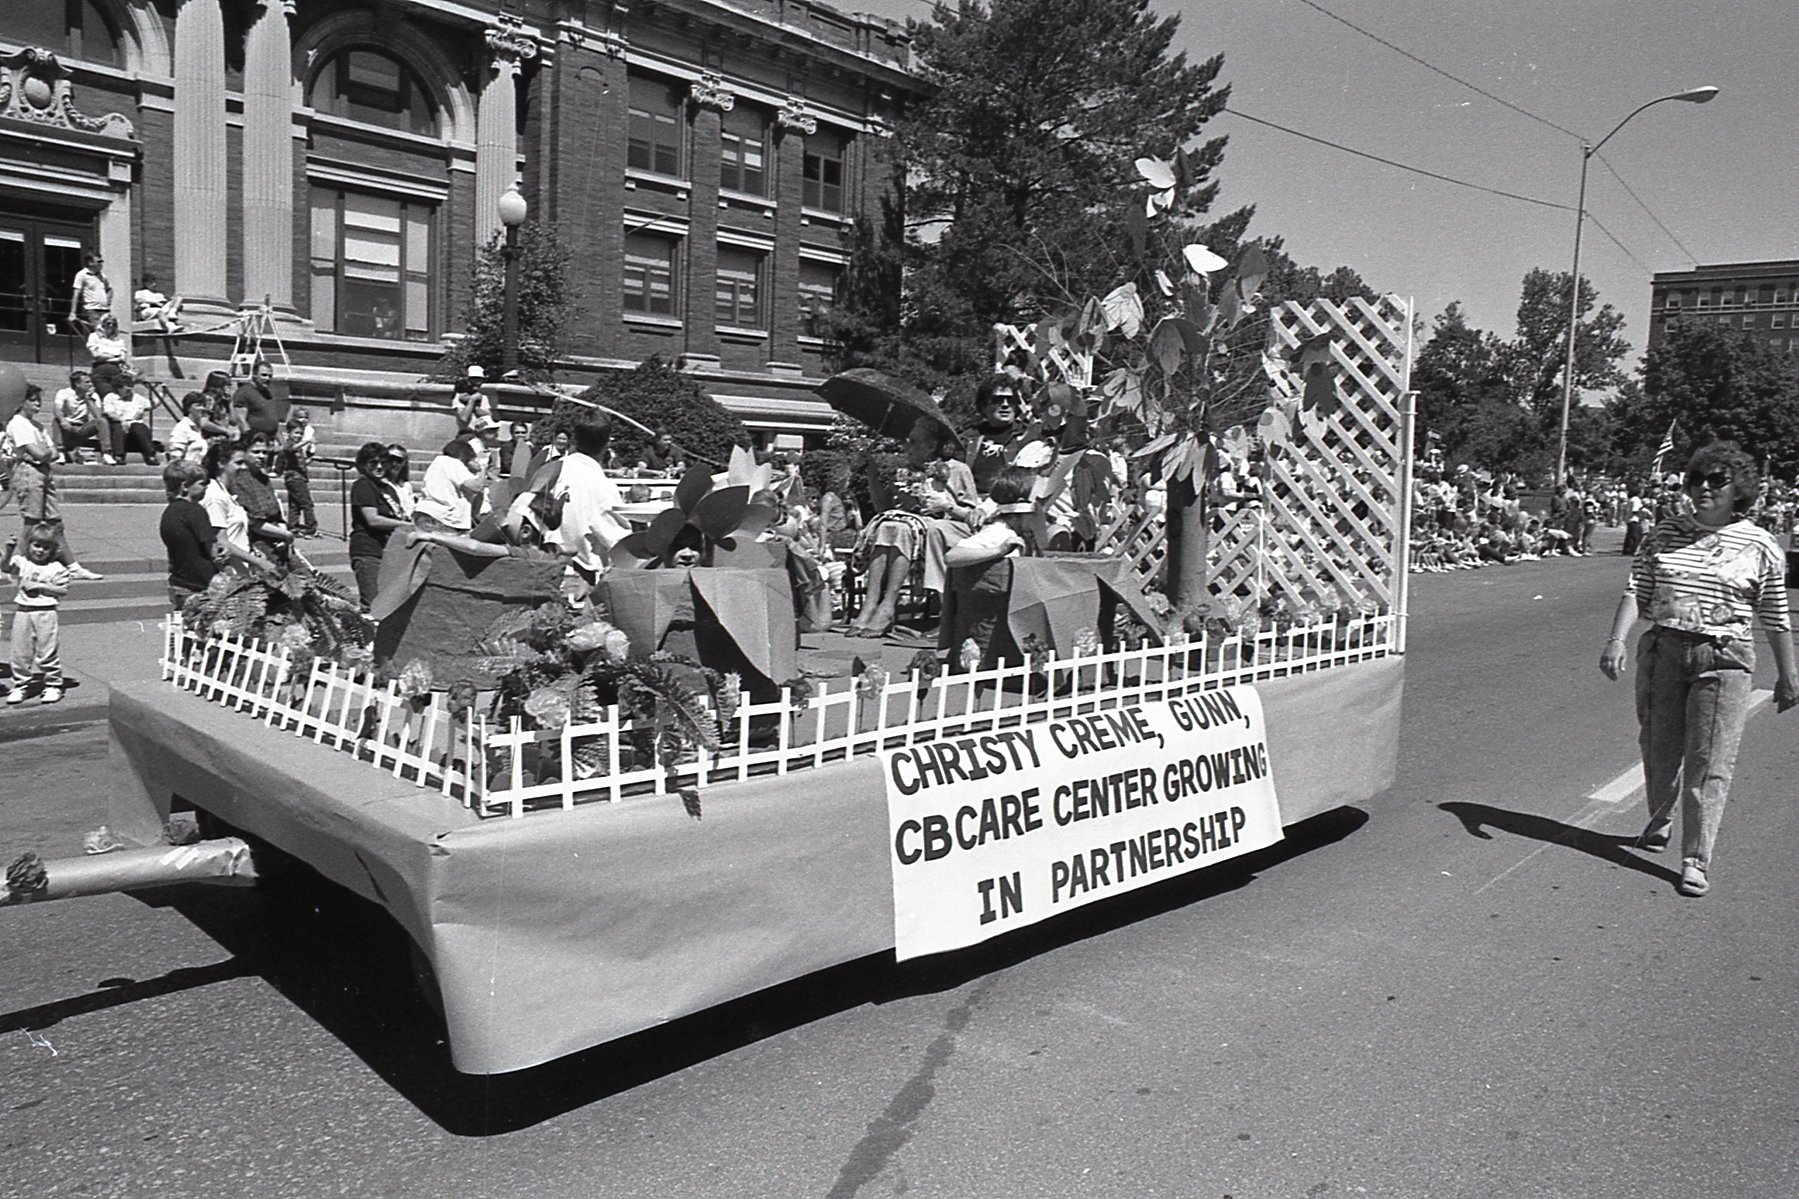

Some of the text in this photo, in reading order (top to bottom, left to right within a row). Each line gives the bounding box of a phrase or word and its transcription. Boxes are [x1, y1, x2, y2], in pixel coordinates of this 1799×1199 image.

[891, 689, 1250, 796] CHRISTY CREME, GUNN,
[1054, 767, 1158, 827] CENTER
[1164, 742, 1267, 802] GROWING
[978, 806, 1246, 925] IN PARTNERSHIP
